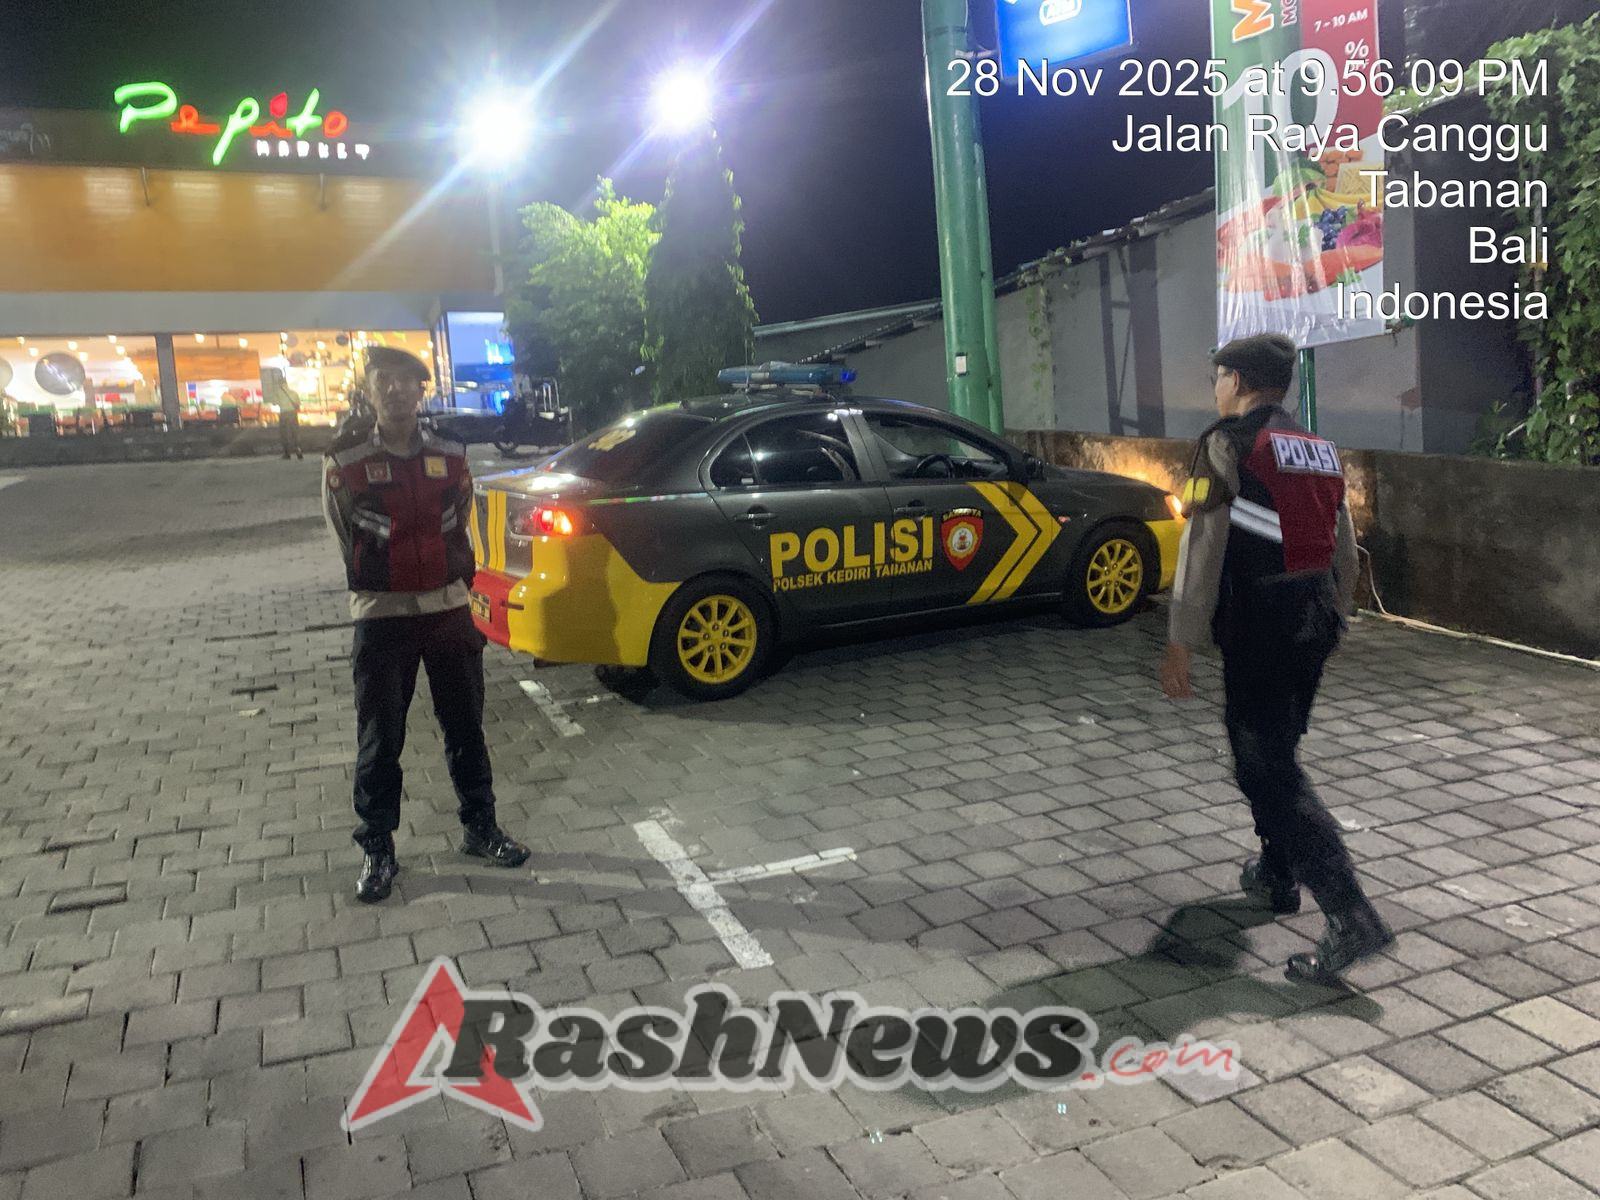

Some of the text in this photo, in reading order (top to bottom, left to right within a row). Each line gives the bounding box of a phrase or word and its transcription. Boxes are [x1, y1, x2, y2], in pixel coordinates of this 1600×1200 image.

[1314, 20, 1322, 32] 7
[1333, 14, 1346, 27] 10
[1348, 8, 1368, 24] AM
[1273, 437, 1340, 471] POLISI
[769, 515, 934, 578] POLISI
[772, 559, 932, 593] POLSEK KEDIRI TABANAN
